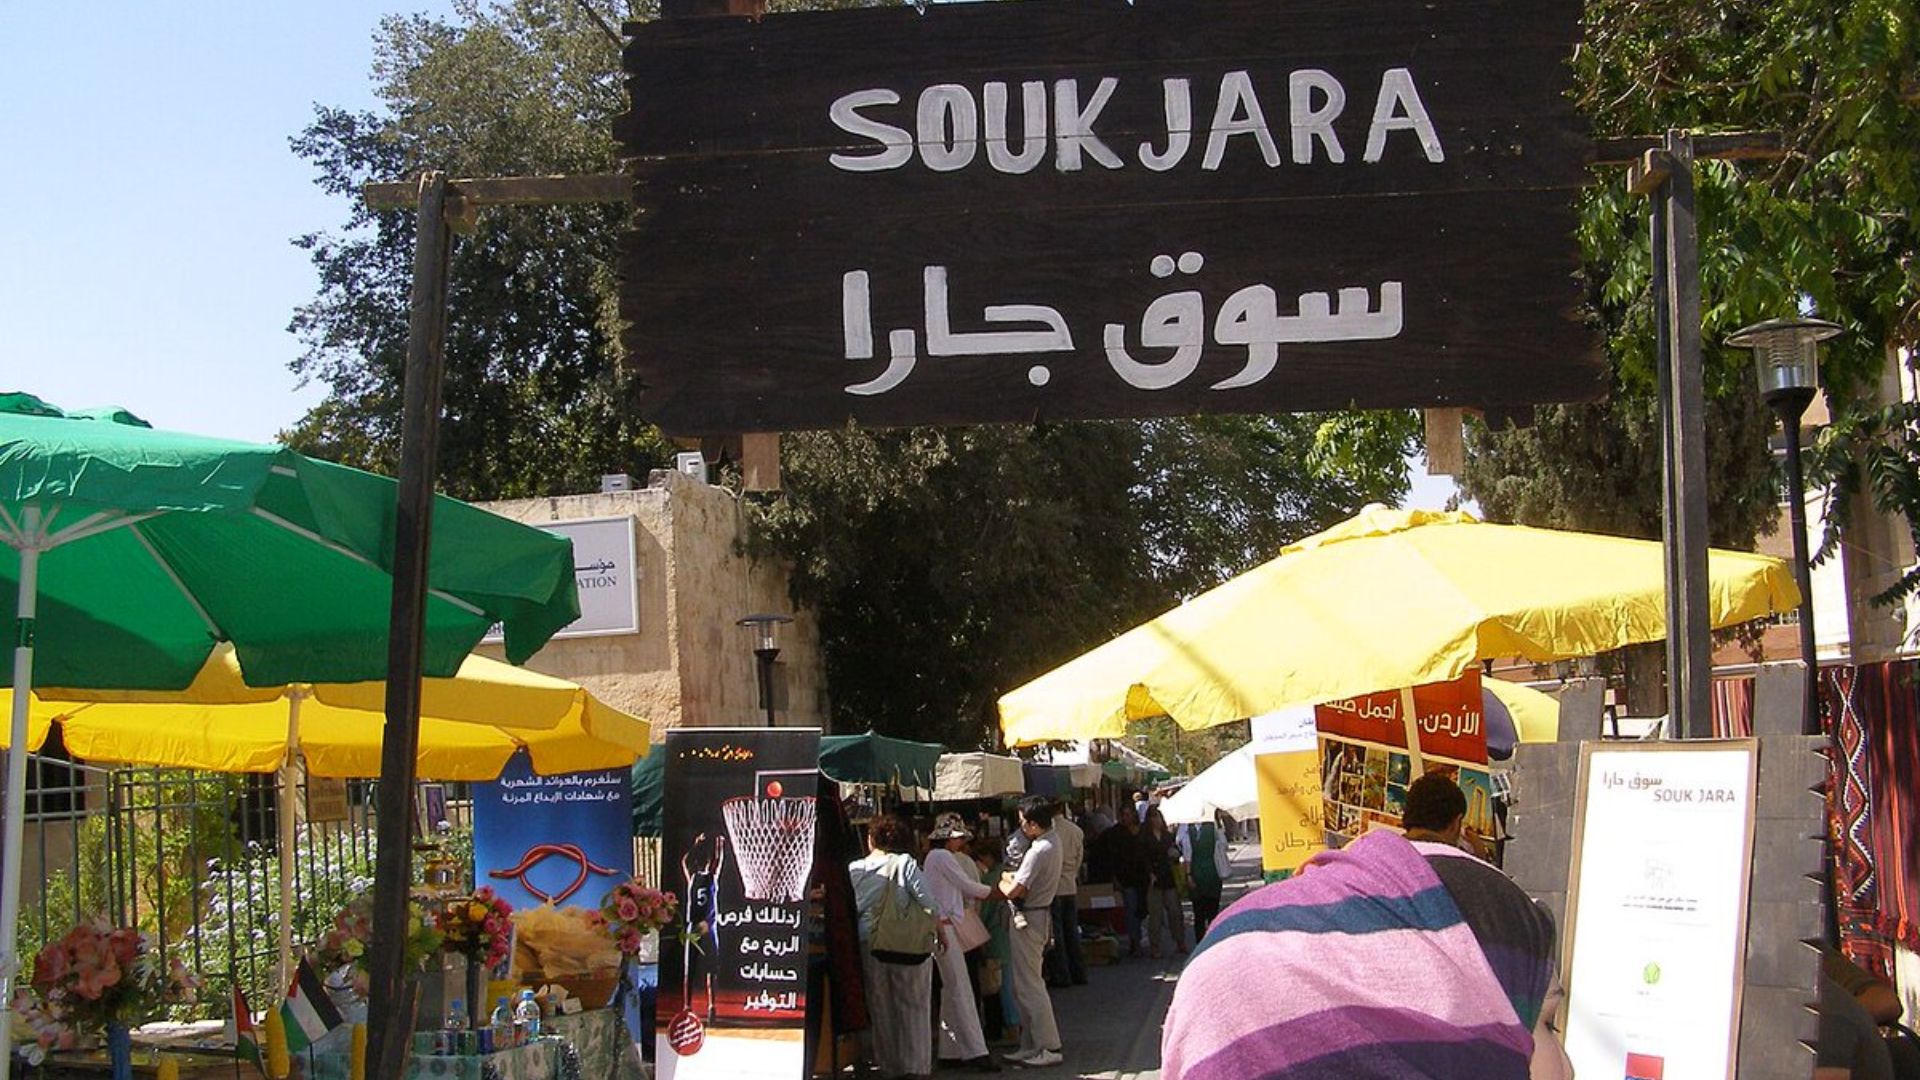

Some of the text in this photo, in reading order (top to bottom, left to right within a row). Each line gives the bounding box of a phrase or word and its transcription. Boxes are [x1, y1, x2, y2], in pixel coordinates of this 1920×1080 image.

[828, 67, 1445, 174] SOUK JARA
[842, 251, 1403, 396] سوق جارا
[1653, 788, 1736, 803] SOUK JARA
[697, 888, 708, 906] 5
[717, 905, 753, 926] فرص
[740, 935, 800, 956] الربح مع
[740, 962, 798, 981] حسابات
[744, 989, 797, 1012] التوفير
